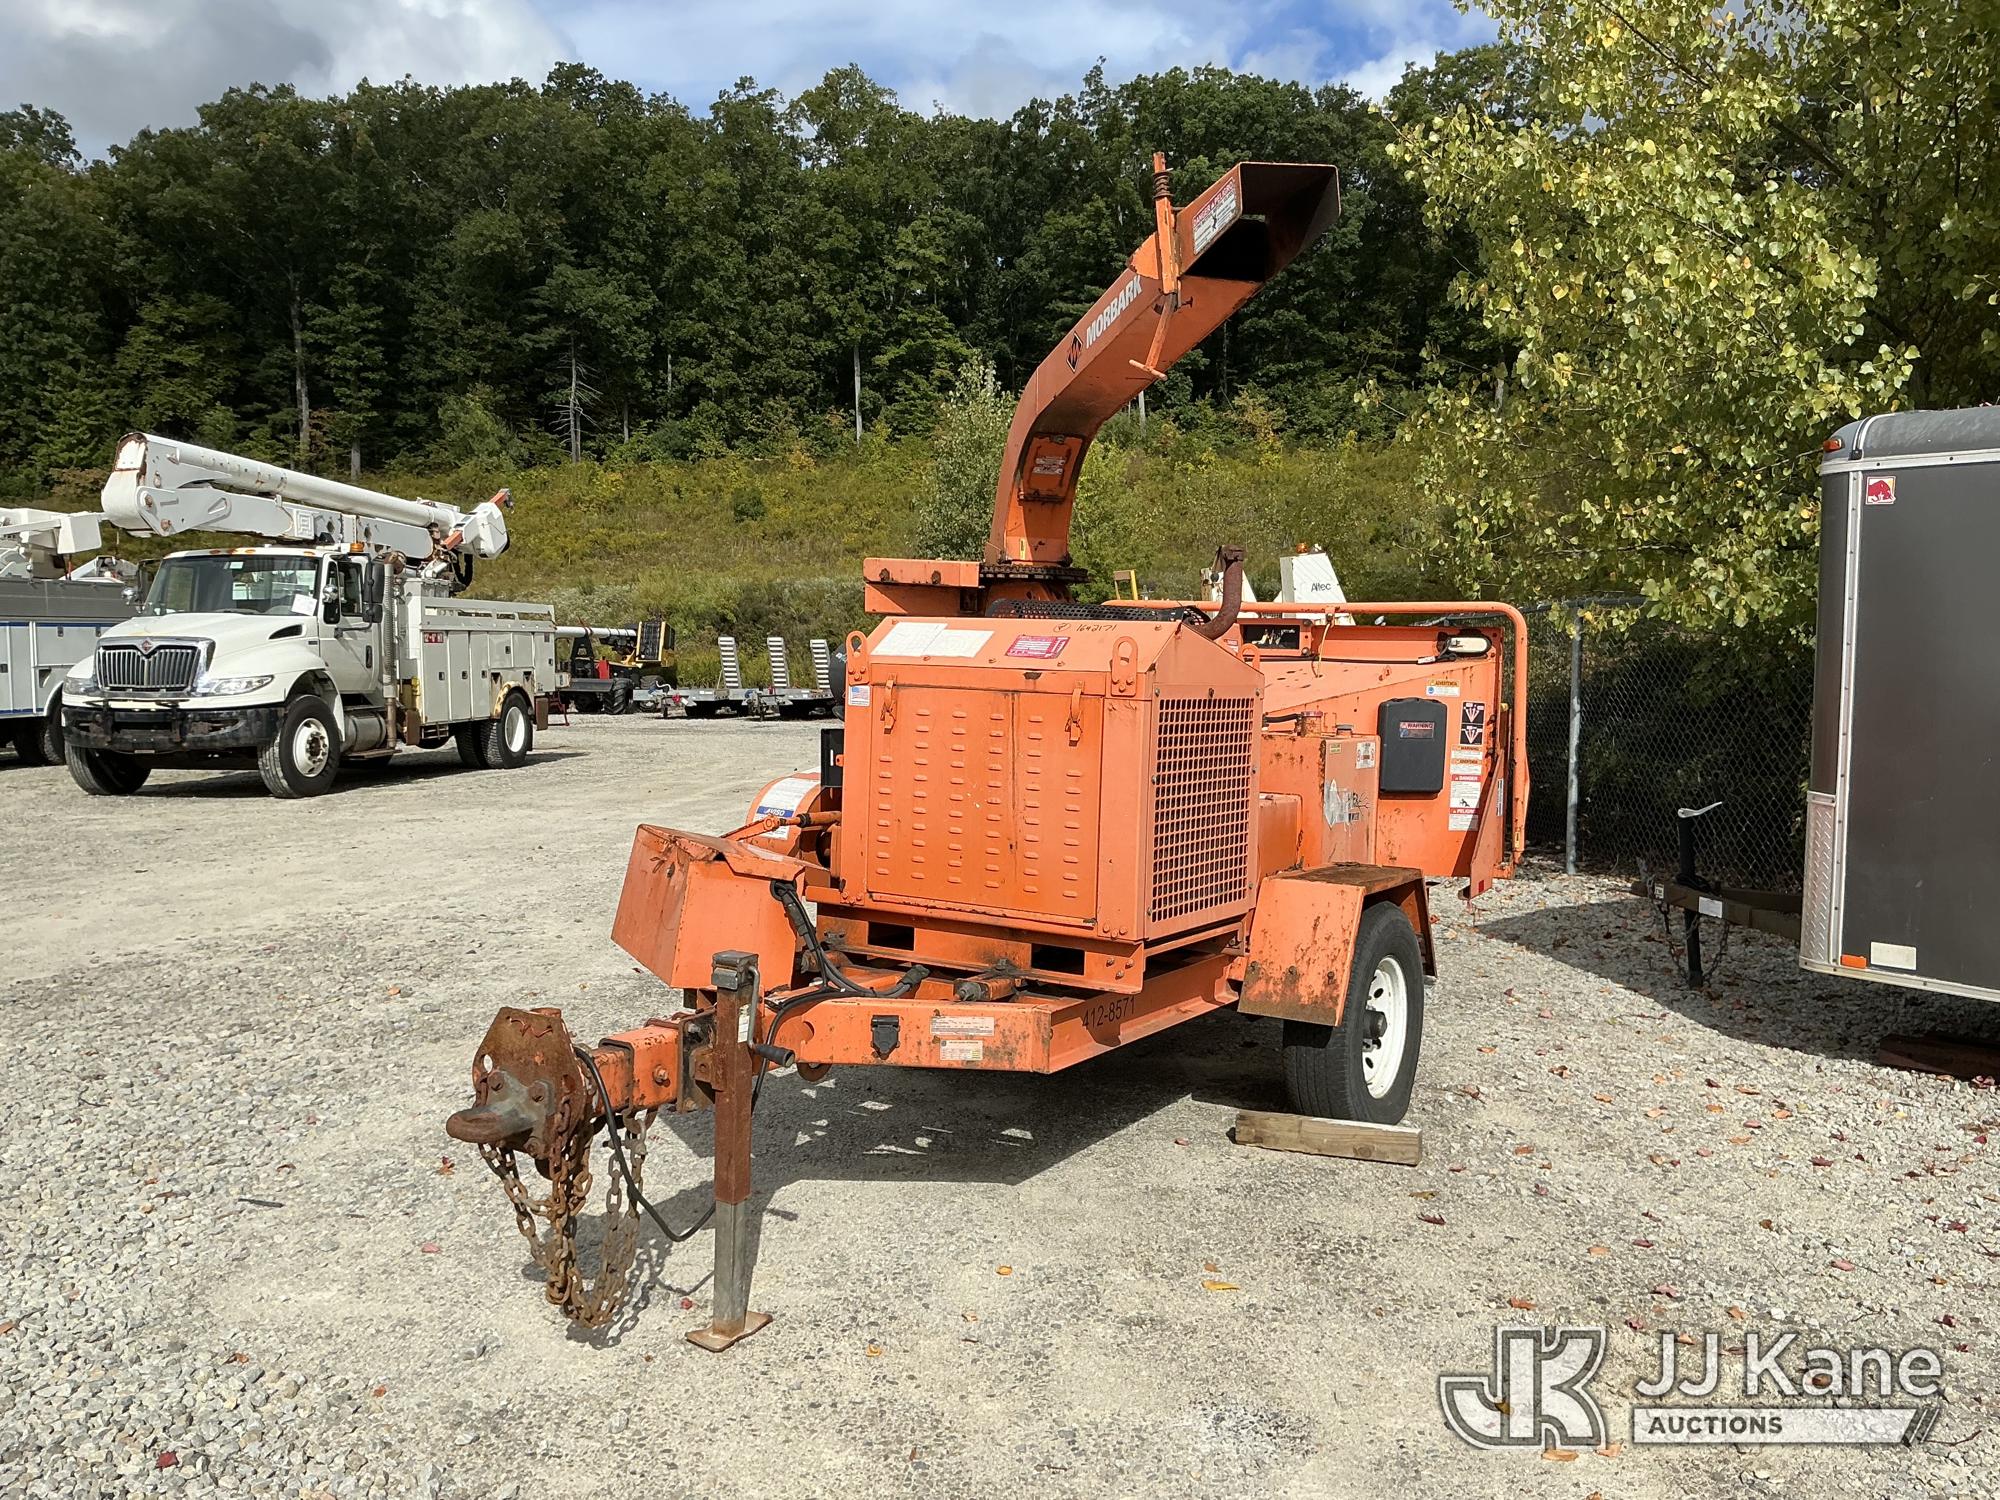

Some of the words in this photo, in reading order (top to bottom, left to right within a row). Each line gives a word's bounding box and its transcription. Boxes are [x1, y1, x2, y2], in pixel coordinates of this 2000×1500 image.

[1085, 274, 1143, 349] MORBARK
[1311, 582, 1332, 593] Altec
[763, 808, 786, 817] AVISO
[1082, 995, 1136, 1029] 412-8571
